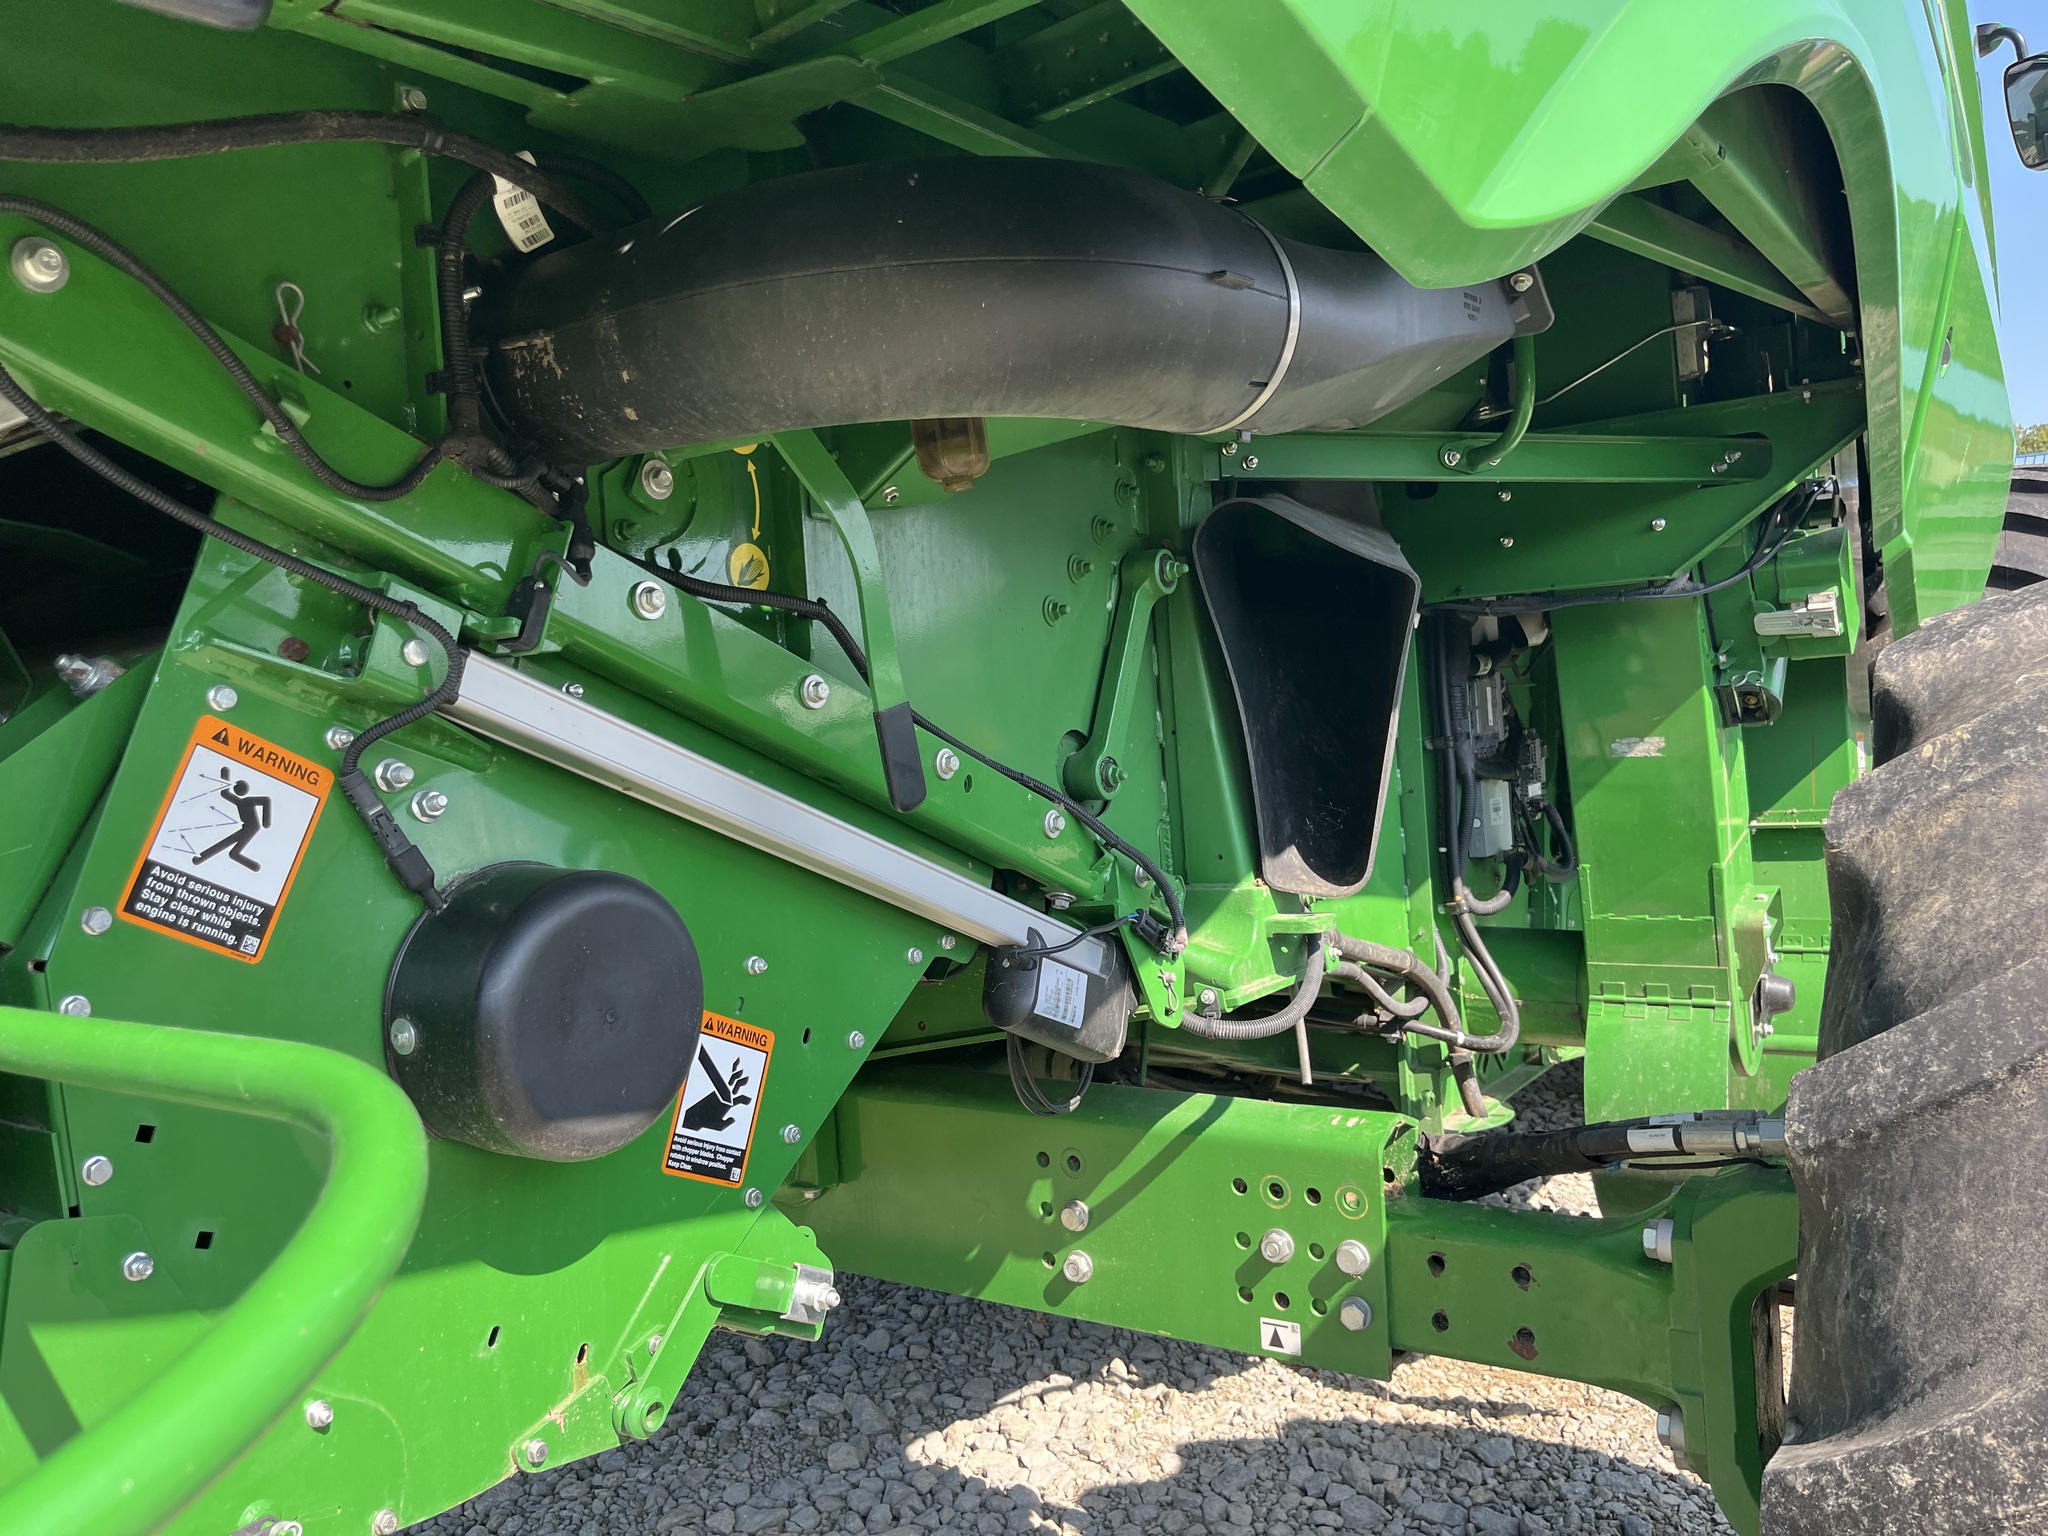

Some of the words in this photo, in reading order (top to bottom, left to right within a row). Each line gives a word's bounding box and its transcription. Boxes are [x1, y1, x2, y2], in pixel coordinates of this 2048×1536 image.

[237, 737, 320, 786] WARNING
[146, 876, 174, 895] from
[176, 888, 216, 910] thrown
[219, 904, 261, 927] objects.
[151, 865, 187, 886] Avoid
[187, 880, 230, 902] serious
[232, 895, 264, 917] injury
[136, 901, 179, 923] engine
[178, 915, 190, 927] is
[191, 922, 238, 945] running.
[141, 888, 169, 907] Stay
[170, 900, 200, 917] clear
[202, 910, 232, 929] while
[716, 1020, 768, 1047] WARNING
[670, 1152, 685, 1161] rotates
[690, 1157, 708, 1166] windrow
[709, 1161, 726, 1169] position.
[674, 1136, 687, 1144] Avoid
[687, 1139, 703, 1147] serious
[703, 1142, 715, 1151] injury
[716, 1145, 725, 1153] from
[726, 1148, 742, 1157] contact
[682, 1146, 700, 1155] chopper
[700, 1150, 714, 1158] blades.
[716, 1154, 734, 1163] Chopper
[668, 1160, 680, 1168] Keep
[680, 1162, 692, 1170] Clear.
